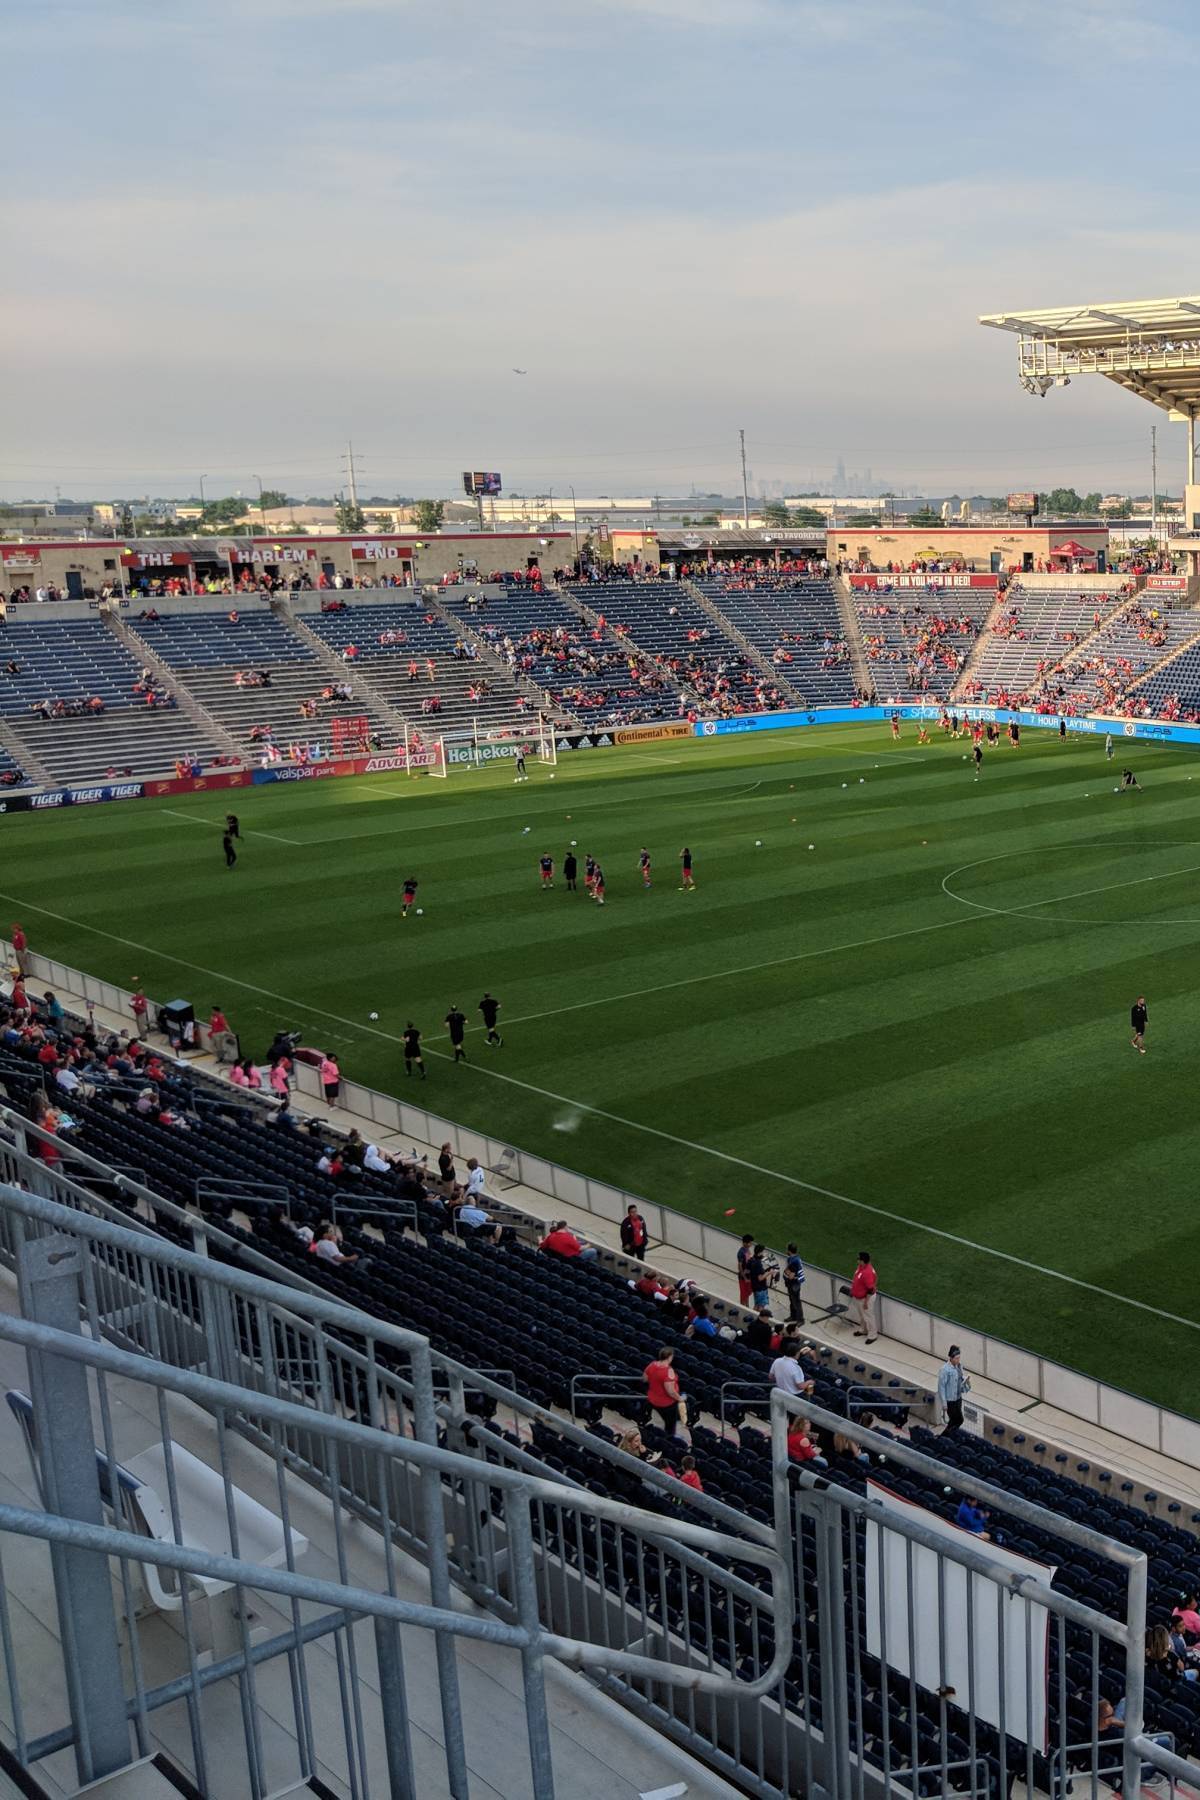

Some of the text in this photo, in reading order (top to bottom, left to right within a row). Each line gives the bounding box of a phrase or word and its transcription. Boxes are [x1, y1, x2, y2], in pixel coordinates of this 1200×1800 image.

[138, 553, 173, 566] THE
[238, 549, 308, 563] HARLEM
[365, 547, 398, 559] END
[877, 575, 971, 586] COME ON YOU MEN IN RED!
[910, 707, 939, 717] SPOR
[1038, 717, 1059, 727] HOUR
[1065, 719, 1097, 730] LAYTIME
[617, 727, 689, 744] Continental TIRE
[448, 744, 519, 763] Heineken
[275, 766, 336, 781] valspar paint
[71, 788, 104, 802] TIGER
[110, 784, 142, 798] TIGER
[31, 792, 64, 806] TIGER
